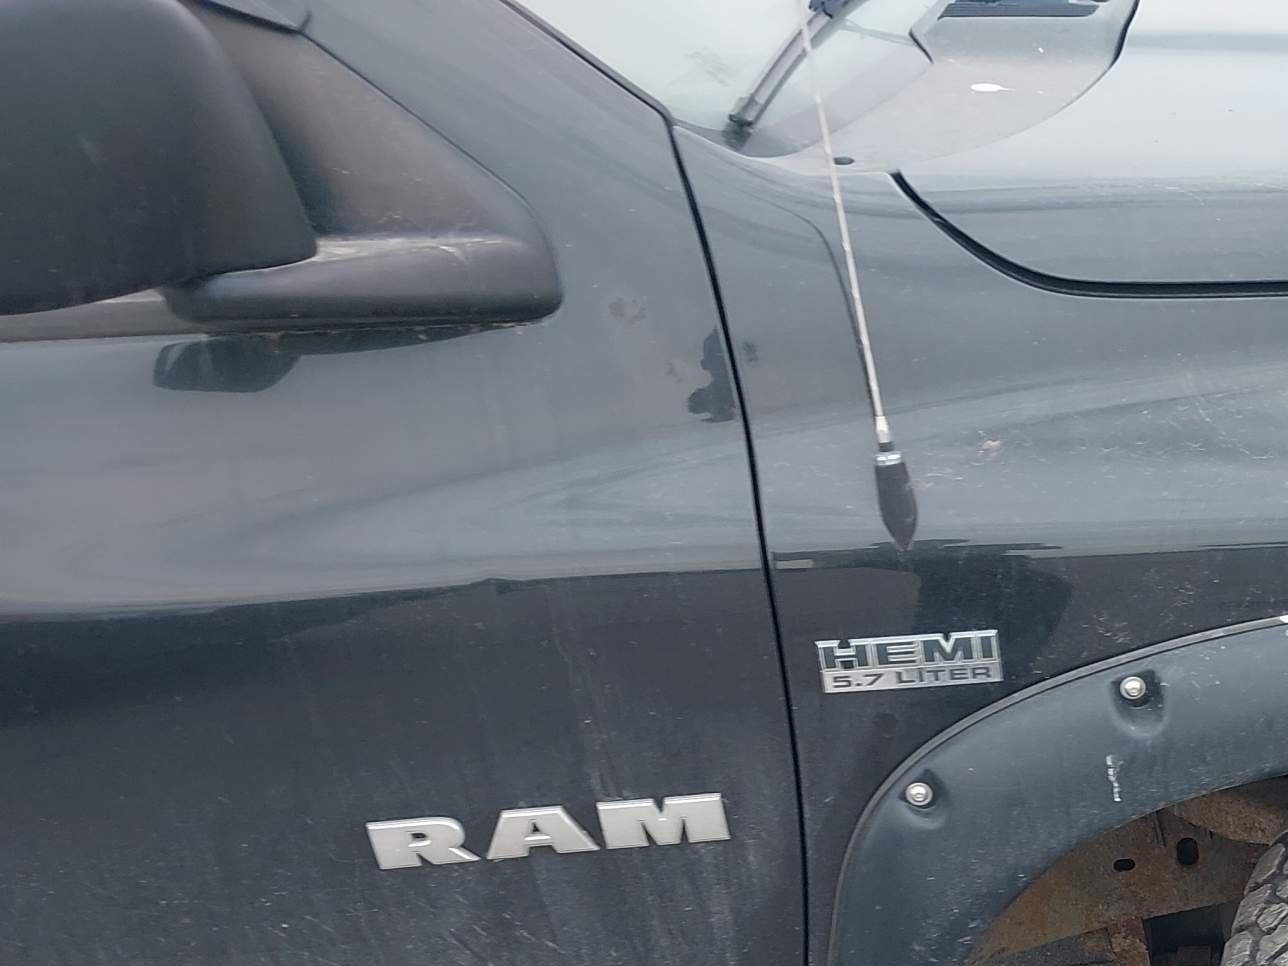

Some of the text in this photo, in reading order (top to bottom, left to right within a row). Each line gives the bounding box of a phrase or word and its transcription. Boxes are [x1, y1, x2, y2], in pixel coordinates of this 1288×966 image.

[814, 629, 1000, 671] HEMI
[832, 666, 992, 689] 5.7 LITER
[366, 792, 731, 870] RAM
